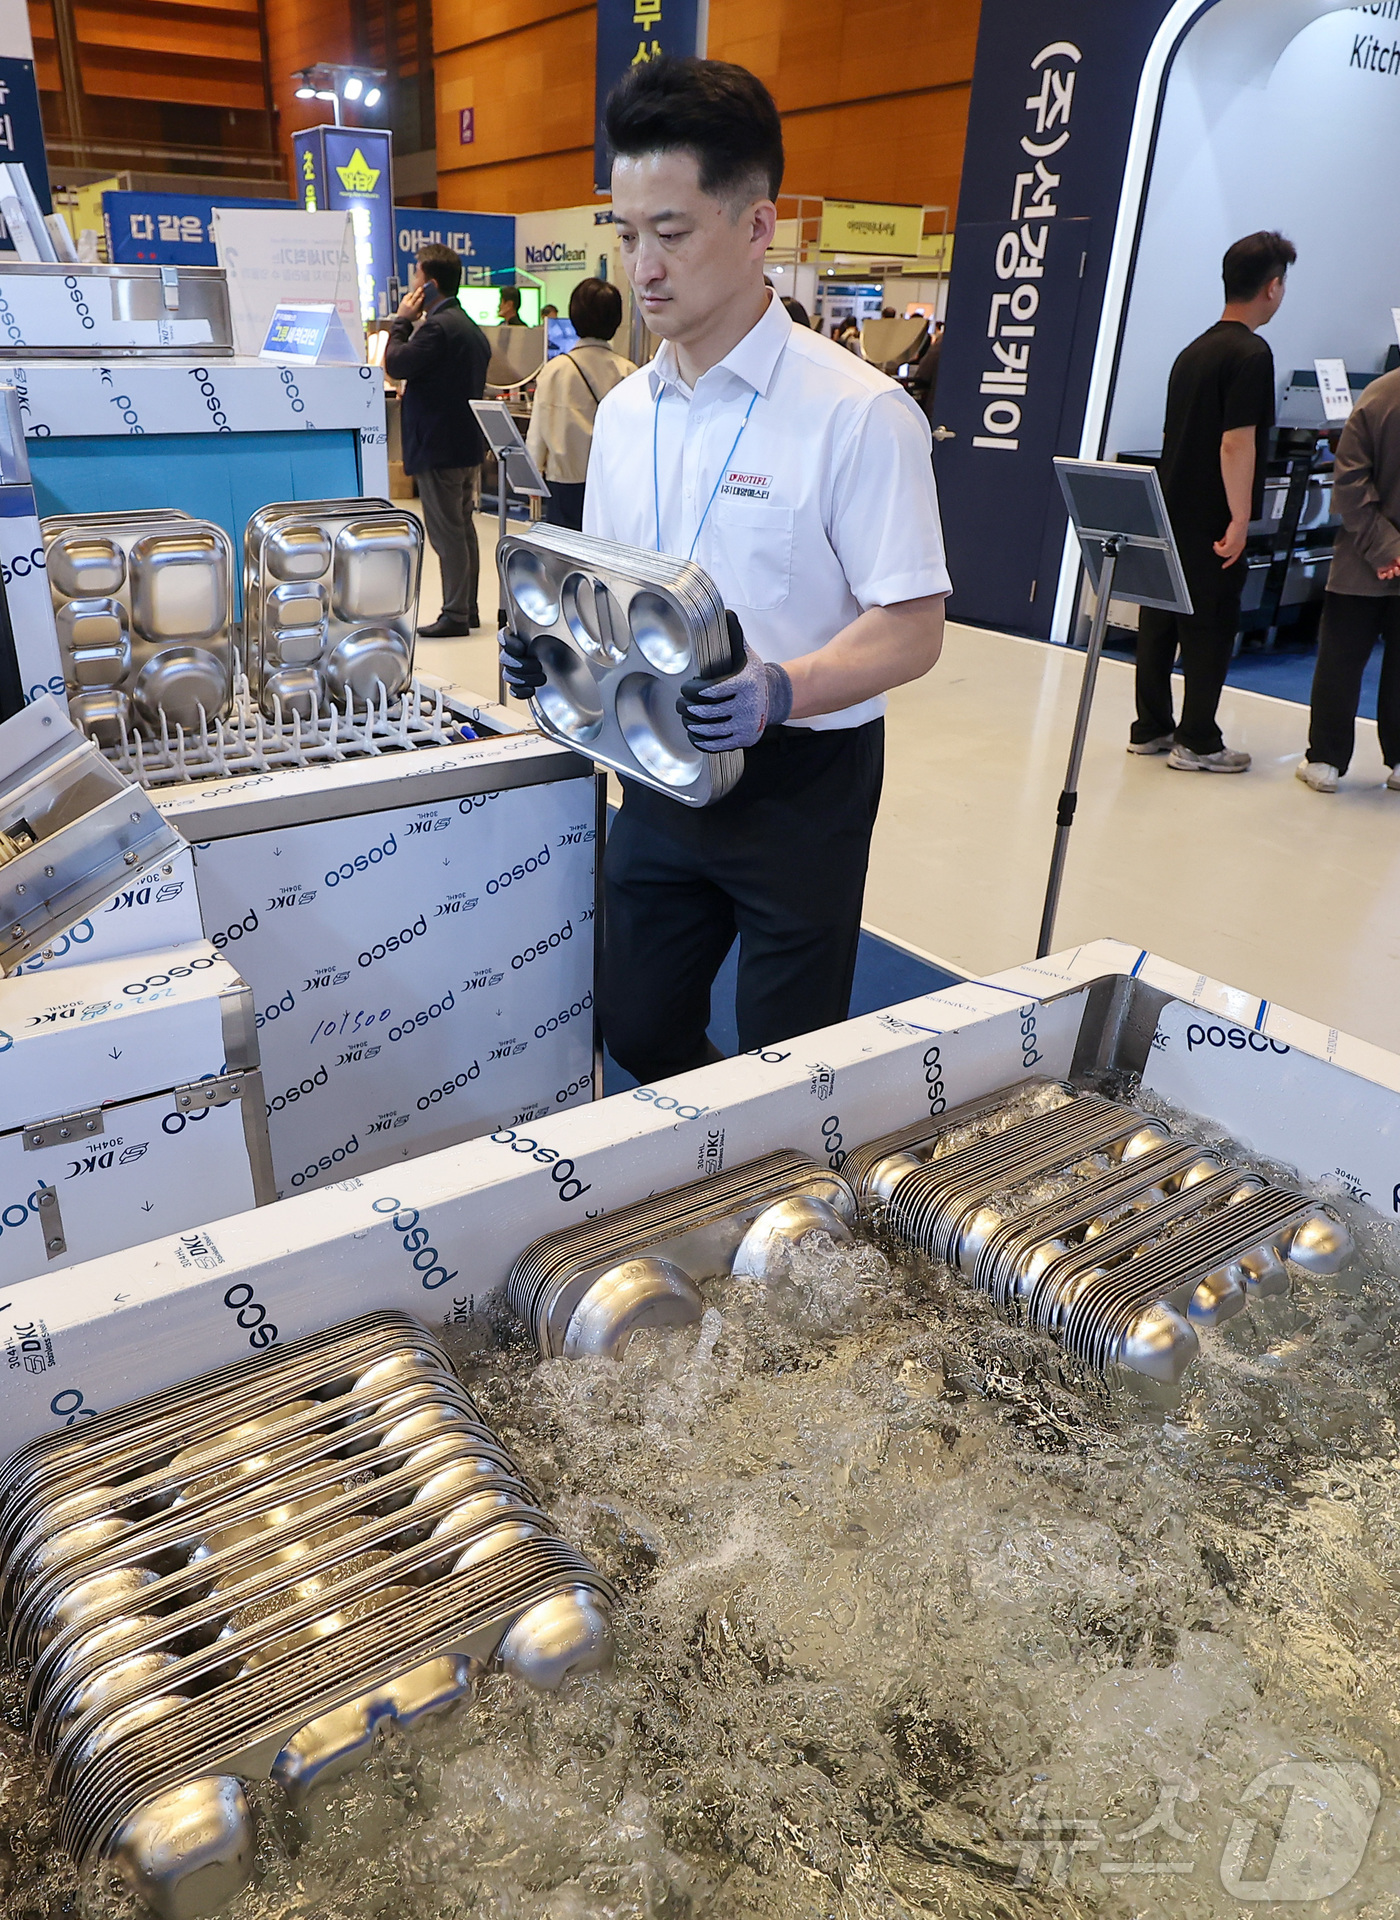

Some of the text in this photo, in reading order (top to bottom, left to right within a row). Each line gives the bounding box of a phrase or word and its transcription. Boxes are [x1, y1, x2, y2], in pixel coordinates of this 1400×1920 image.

[130, 214, 154, 240] 다
[525, 243, 586, 264] NaOClean
[971, 40, 1082, 451] (주)선경인케이
[276, 366, 305, 413] sco
[403, 819, 432, 837] DKC
[556, 831, 582, 848] DKC
[324, 832, 398, 888] posco
[485, 843, 551, 895] posco
[265, 893, 297, 912] DKC
[432, 900, 461, 918] DKC
[357, 913, 428, 968] posco
[510, 919, 573, 970] posco
[300, 974, 331, 993] DKC
[460, 976, 487, 993] DKC
[24, 1008, 76, 1029] DKC
[388, 989, 455, 1042] posco
[534, 989, 593, 1039] posco
[334, 1049, 363, 1067] DKC
[486, 1045, 512, 1062] DKC
[416, 1059, 481, 1111] posco
[555, 1069, 595, 1104] sco
[365, 1118, 393, 1136] DKC
[510, 1110, 534, 1127] DKC
[85, 1136, 125, 1153] 304HL
[706, 1129, 720, 1158] DKC
[64, 1155, 115, 1180] DKC
[290, 1133, 360, 1187] posco
[1334, 1167, 1362, 1187] 304HL
[180, 1234, 209, 1258] DKC
[371, 1196, 459, 1291] posco
[223, 1282, 282, 1350] sco
[13, 1321, 42, 1353] DKC
